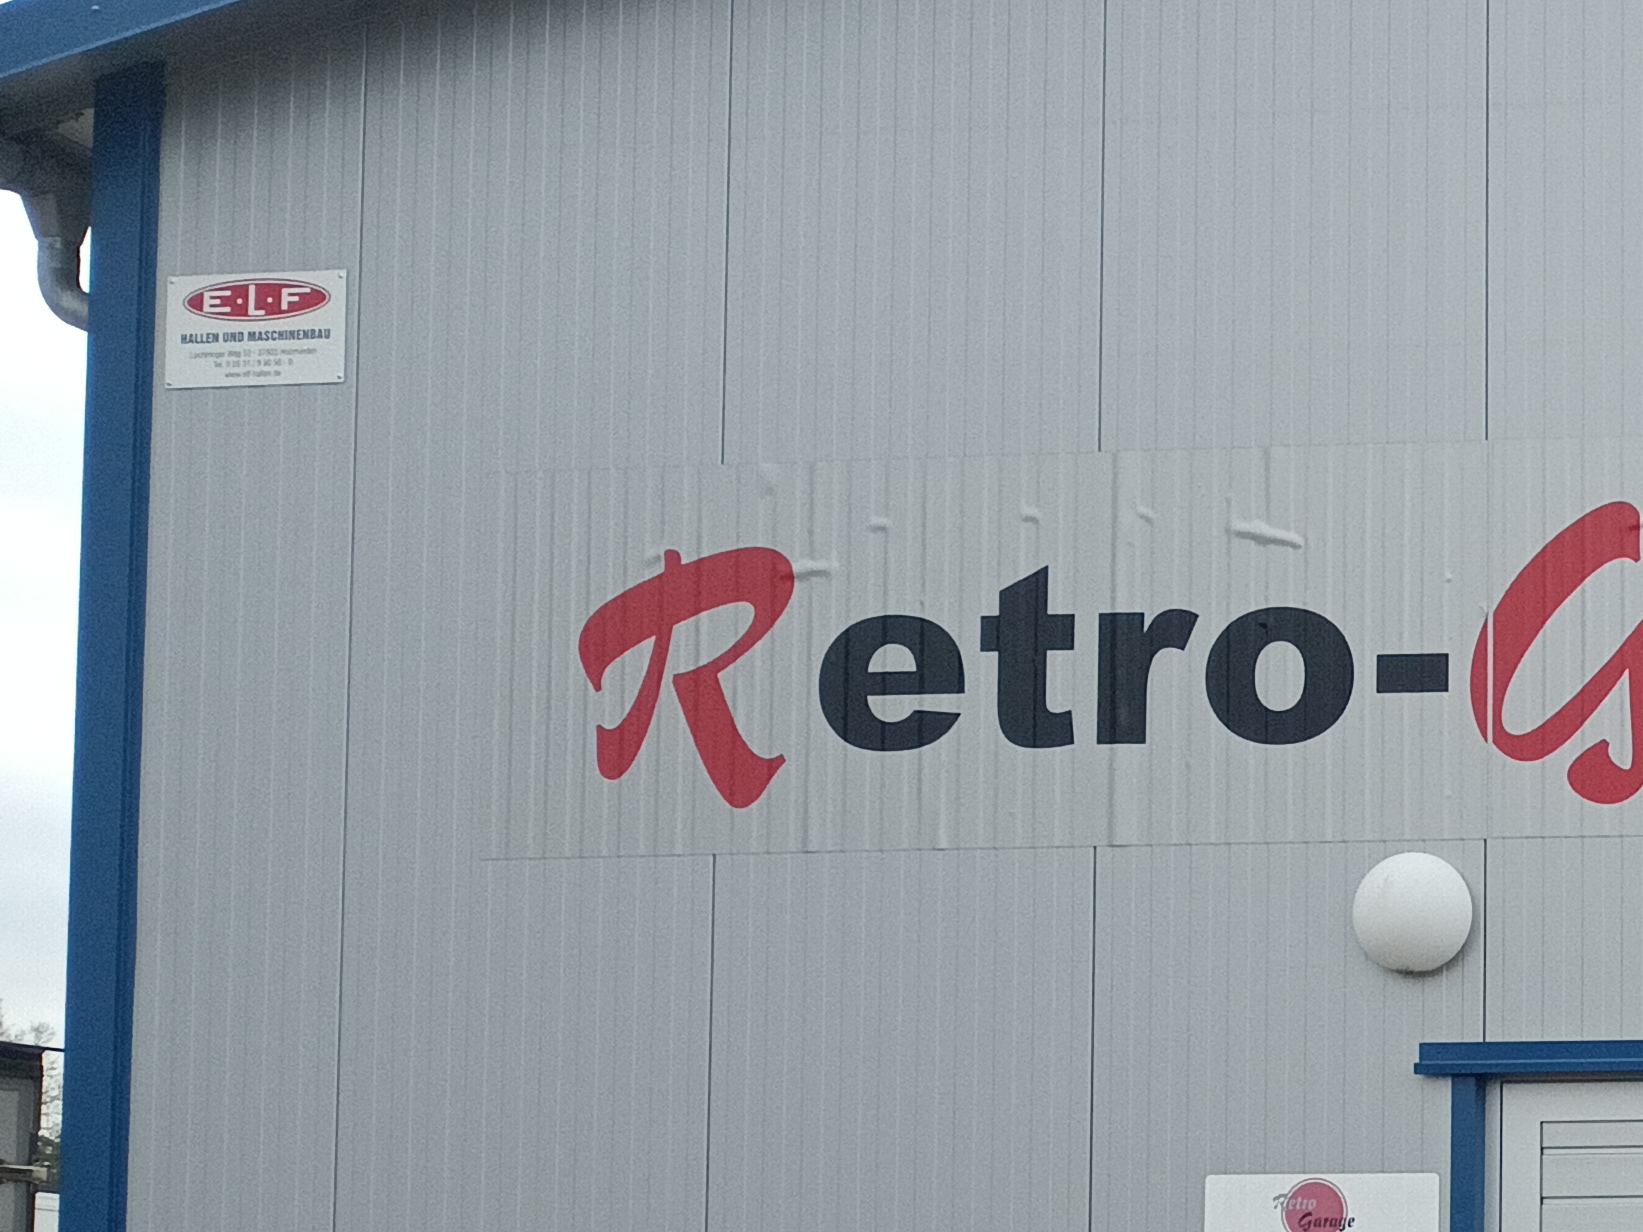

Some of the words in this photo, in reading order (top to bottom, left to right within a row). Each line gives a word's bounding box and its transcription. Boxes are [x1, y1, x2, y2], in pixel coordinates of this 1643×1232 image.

[181, 332, 220, 344] HALLEN
[222, 331, 244, 343] UND
[247, 328, 331, 342] MASCHINENBAU
[1272, 1193, 1317, 1211] Retro
[1297, 1211, 1355, 1232] Garage
